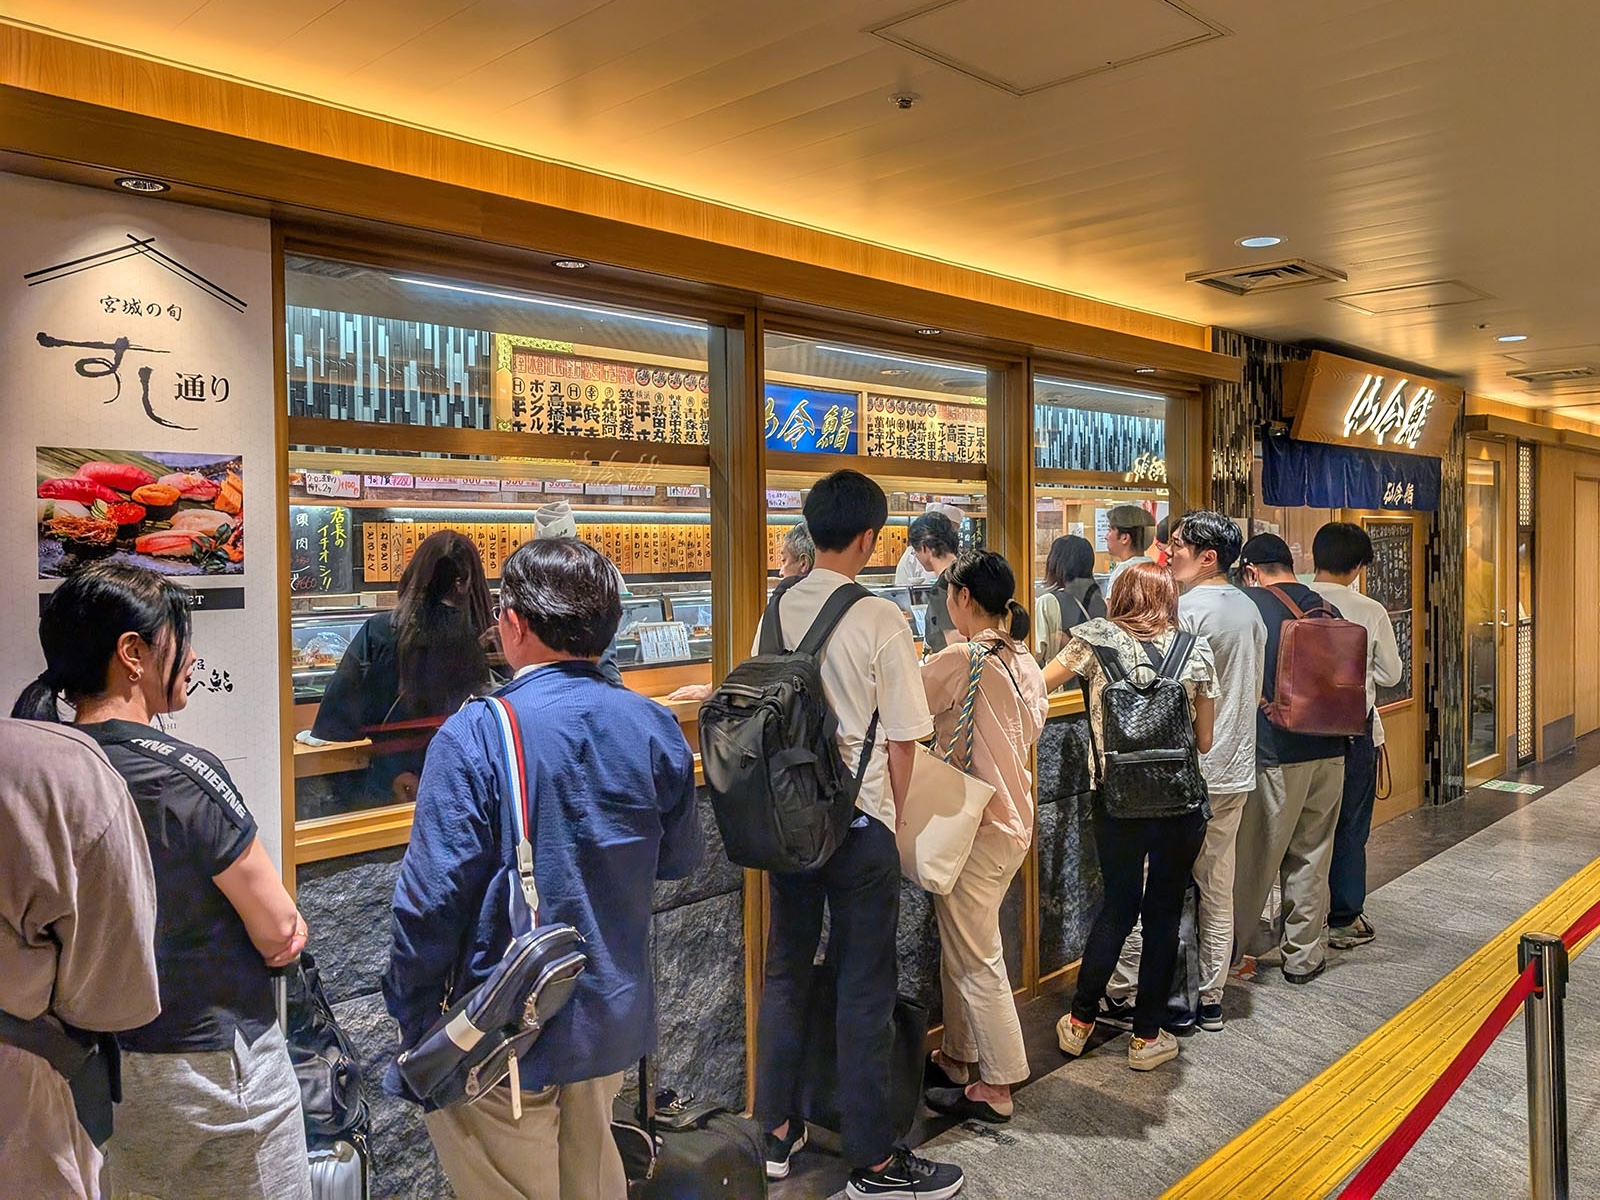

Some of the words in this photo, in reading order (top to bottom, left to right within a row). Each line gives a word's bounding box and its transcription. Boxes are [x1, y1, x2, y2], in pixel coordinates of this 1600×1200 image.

[100, 295, 181, 321] 宮城の旬
[529, 379, 546, 434] ボングル
[547, 394, 565, 434] 高橋水
[602, 399, 617, 438] 丸徳阿
[906, 420, 917, 459] 仙台宮
[957, 424, 967, 463] 三宝化
[331, 506, 347, 548] 店長の
[367, 532, 376, 572] とろたく
[380, 532, 389, 572] ねぎとろ
[179, 752, 247, 819] BRIEFING
